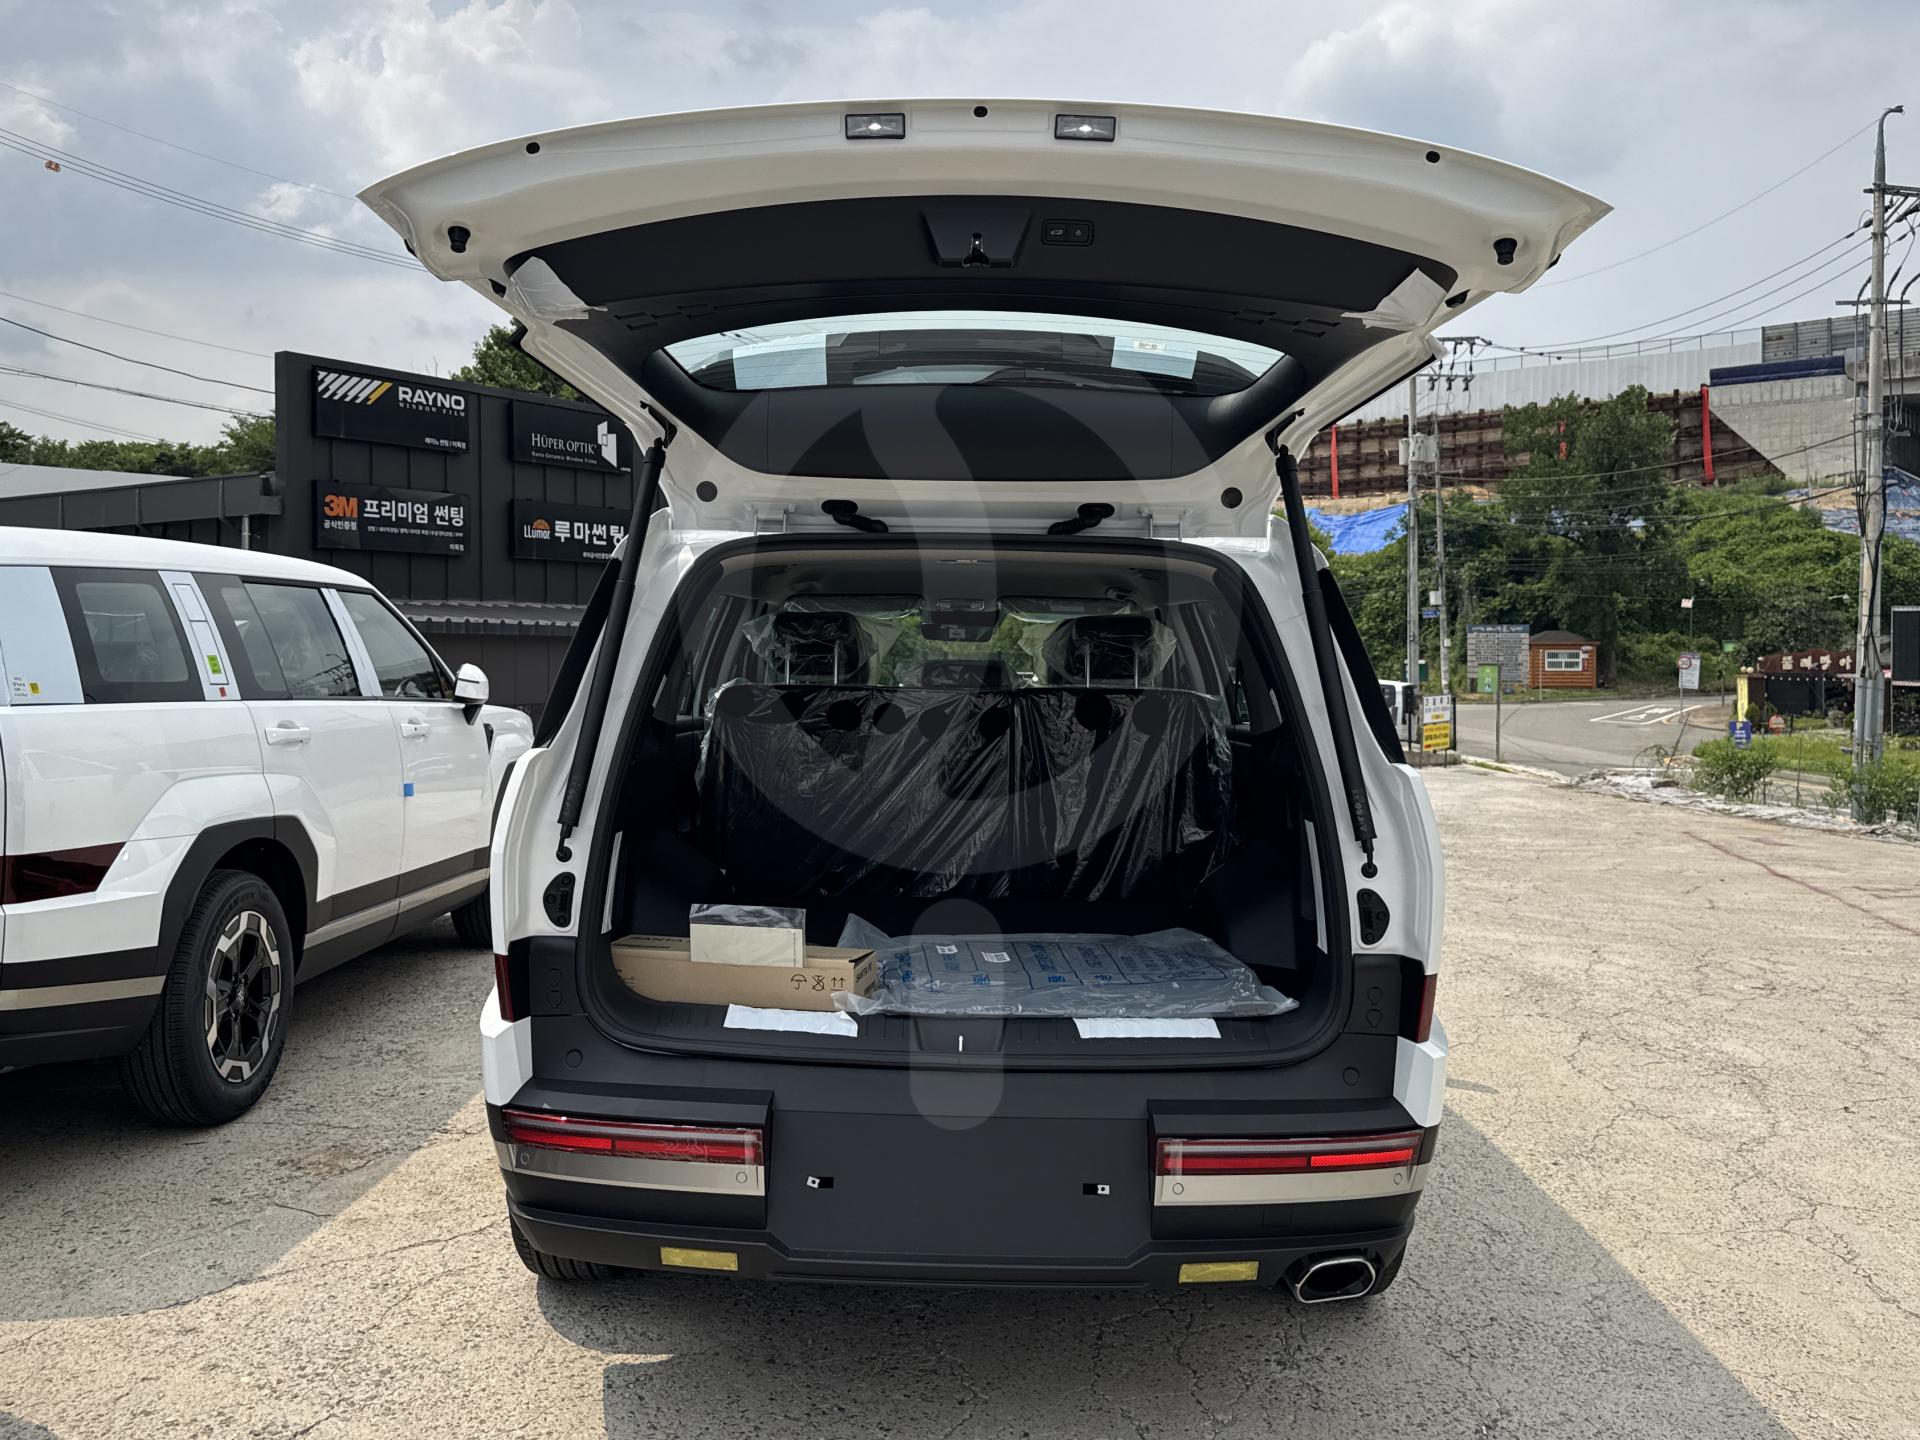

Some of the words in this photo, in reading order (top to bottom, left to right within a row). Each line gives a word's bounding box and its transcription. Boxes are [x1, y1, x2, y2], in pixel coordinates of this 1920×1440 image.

[398, 386, 465, 410] RAYNO
[399, 402, 437, 412] WINDOW
[443, 408, 465, 417] FILM
[323, 494, 358, 519] 3M
[363, 499, 429, 525] 프리미엄
[434, 505, 465, 527] 썬팅
[323, 519, 358, 531] 공식인증점
[554, 520, 625, 547] 루마썬팅
